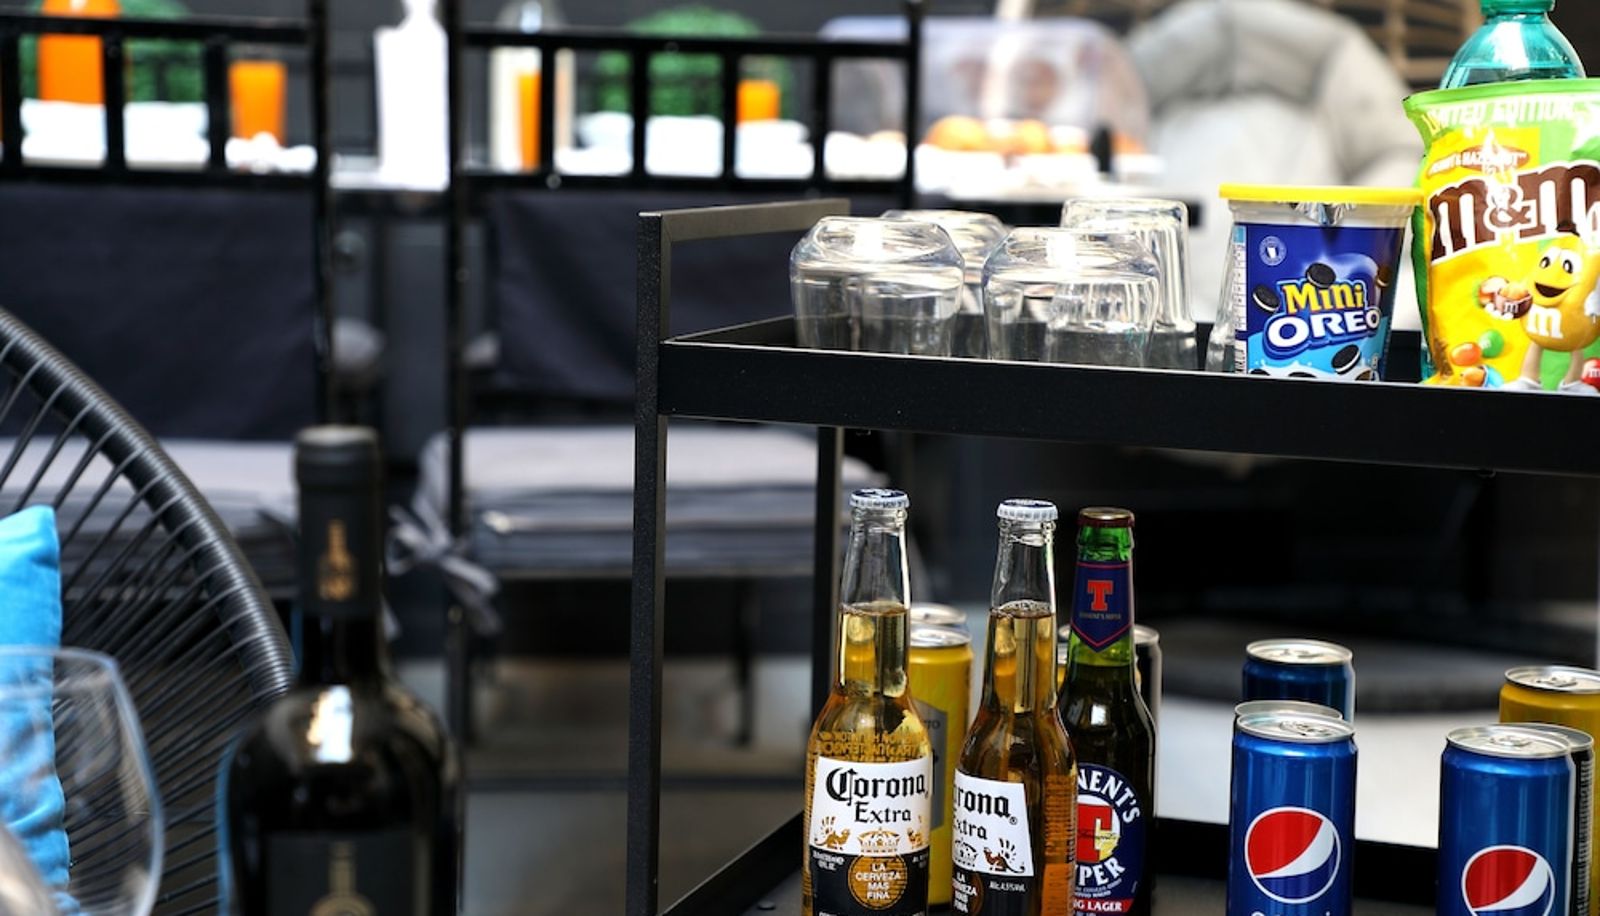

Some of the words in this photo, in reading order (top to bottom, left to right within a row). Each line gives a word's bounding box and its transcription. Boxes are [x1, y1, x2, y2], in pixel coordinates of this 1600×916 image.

[1282, 283, 1364, 314] Mini
[1267, 309, 1380, 348] OREO
[1526, 304, 1564, 339] m
[1087, 579, 1114, 611] T
[825, 766, 926, 807] Corona
[955, 785, 1011, 819] rona
[854, 801, 912, 824] Extra
[955, 818, 988, 841] xtra
[855, 871, 901, 882] CERVEZA
[872, 863, 886, 872] LA
[1076, 856, 1126, 887] PER
[1087, 900, 1123, 912] LAGER
